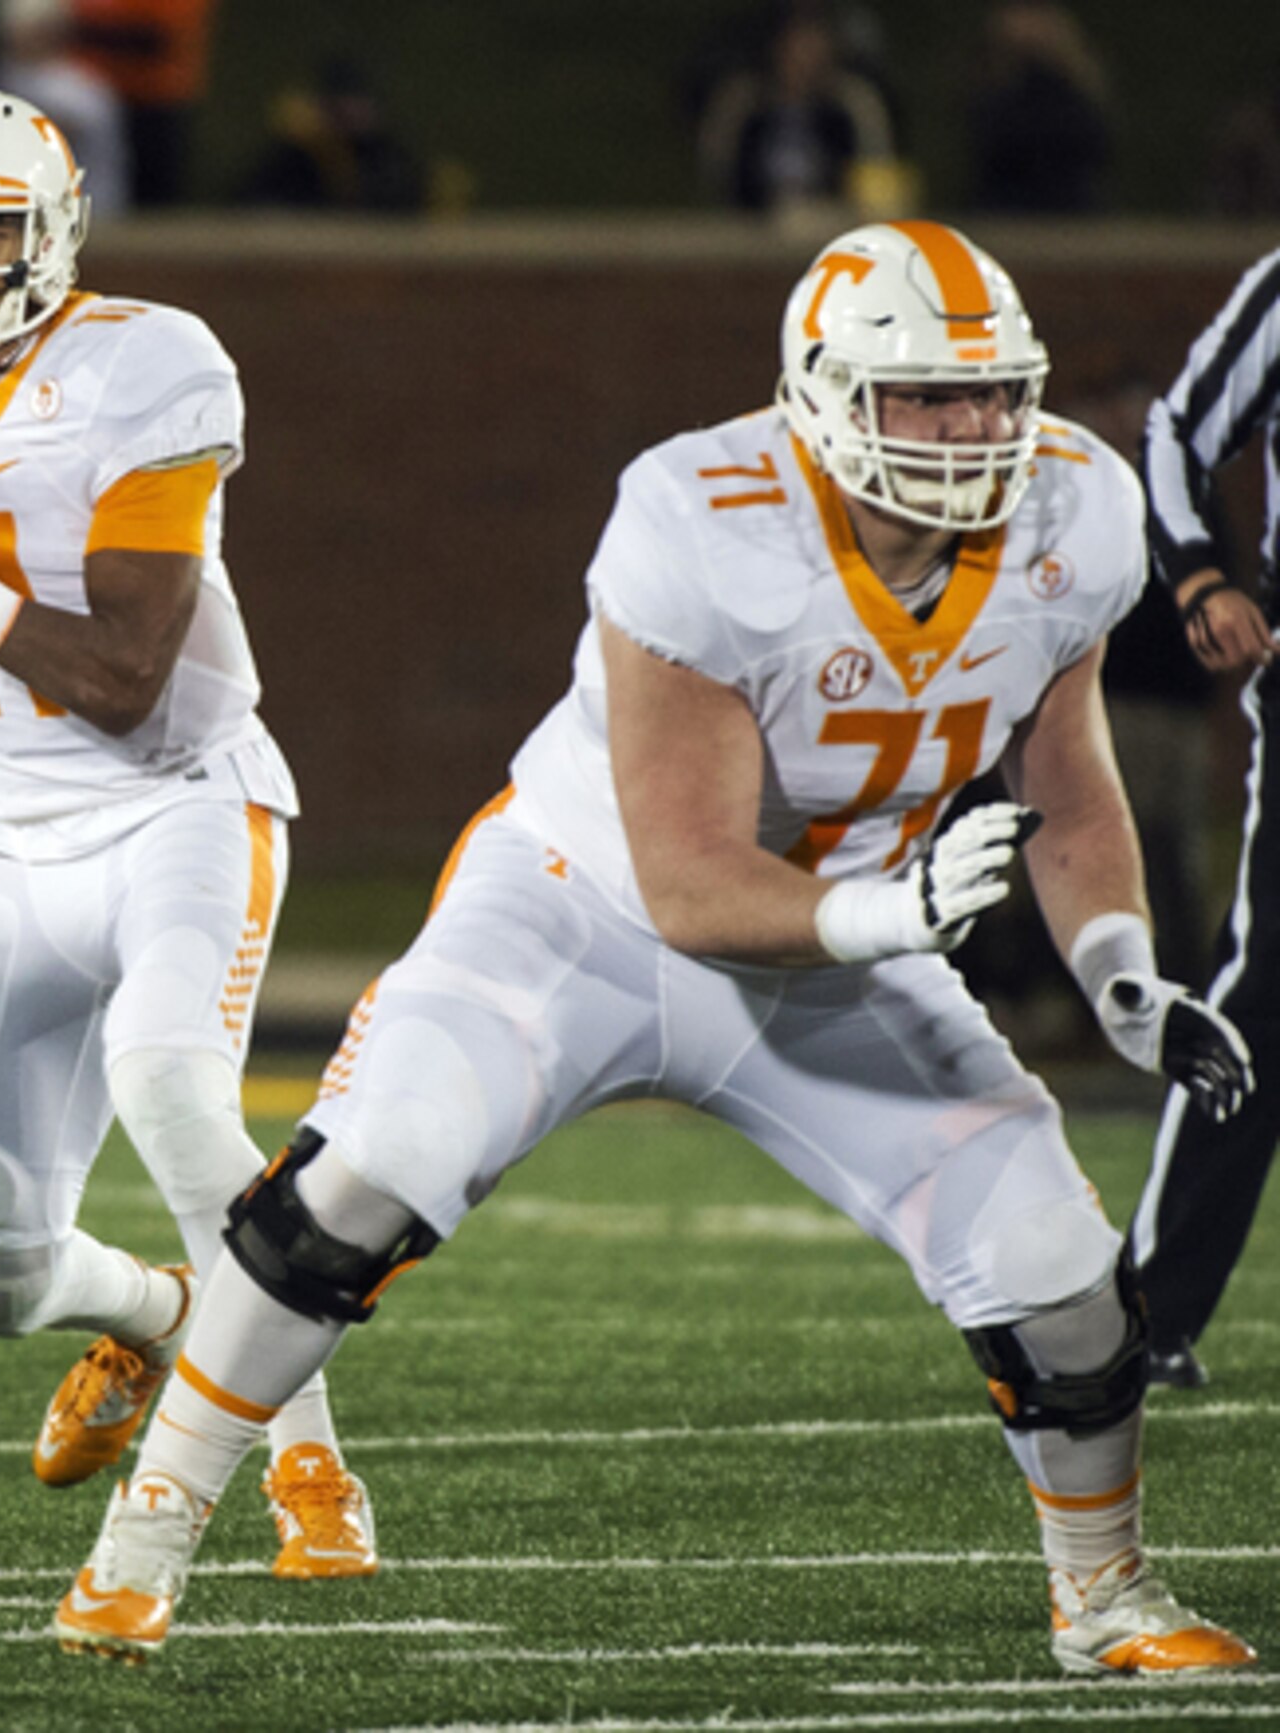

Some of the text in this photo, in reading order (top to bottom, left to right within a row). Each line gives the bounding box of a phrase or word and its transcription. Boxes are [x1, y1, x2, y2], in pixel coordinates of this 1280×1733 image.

[803, 252, 877, 340] T
[697, 452, 789, 511] 71
[908, 651, 939, 682] T
[782, 697, 993, 882] 71
[297, 1456, 321, 1477] T
[140, 1484, 169, 1511] T
